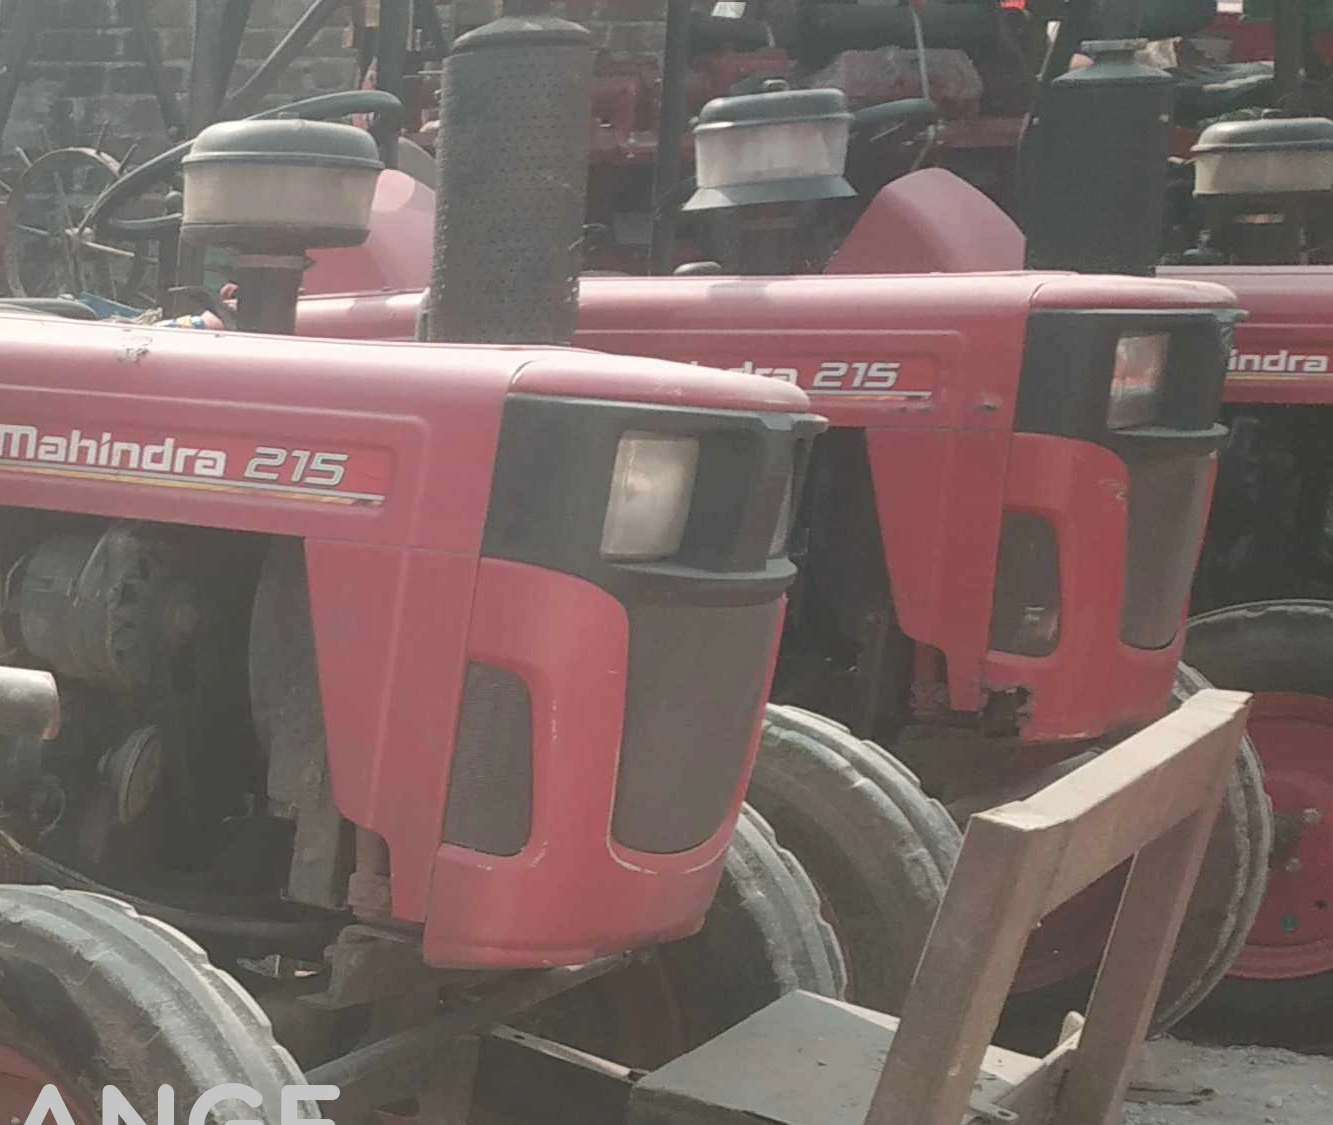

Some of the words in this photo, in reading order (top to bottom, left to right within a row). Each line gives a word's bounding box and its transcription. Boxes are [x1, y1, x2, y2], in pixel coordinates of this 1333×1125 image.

[1227, 348, 1329, 372] indra
[812, 361, 902, 389] 215
[243, 446, 349, 487] 215
